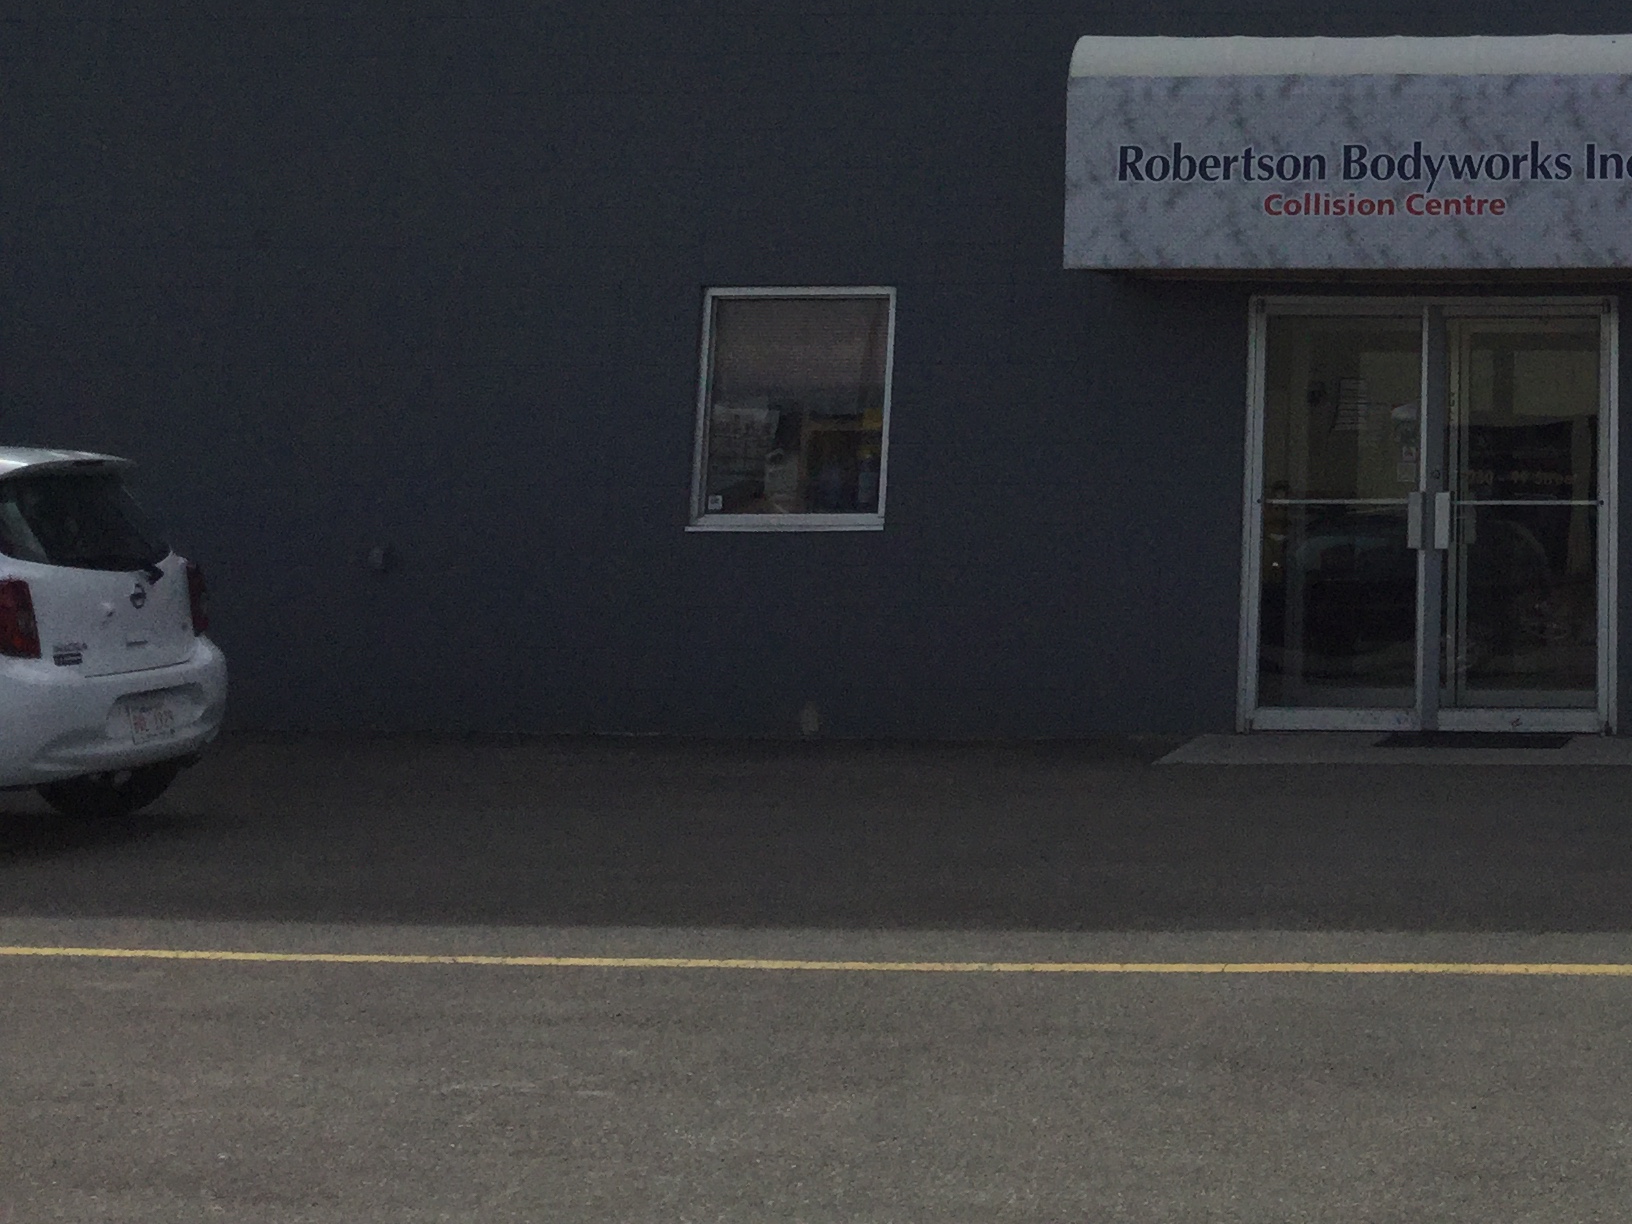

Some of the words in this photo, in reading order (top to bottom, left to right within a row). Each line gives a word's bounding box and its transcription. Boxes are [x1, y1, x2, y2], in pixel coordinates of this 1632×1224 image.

[1118, 143, 1327, 182] Robertson
[1341, 141, 1573, 193] Bodyworks
[1264, 192, 1396, 217] Collision
[1406, 192, 1507, 216] Centre
